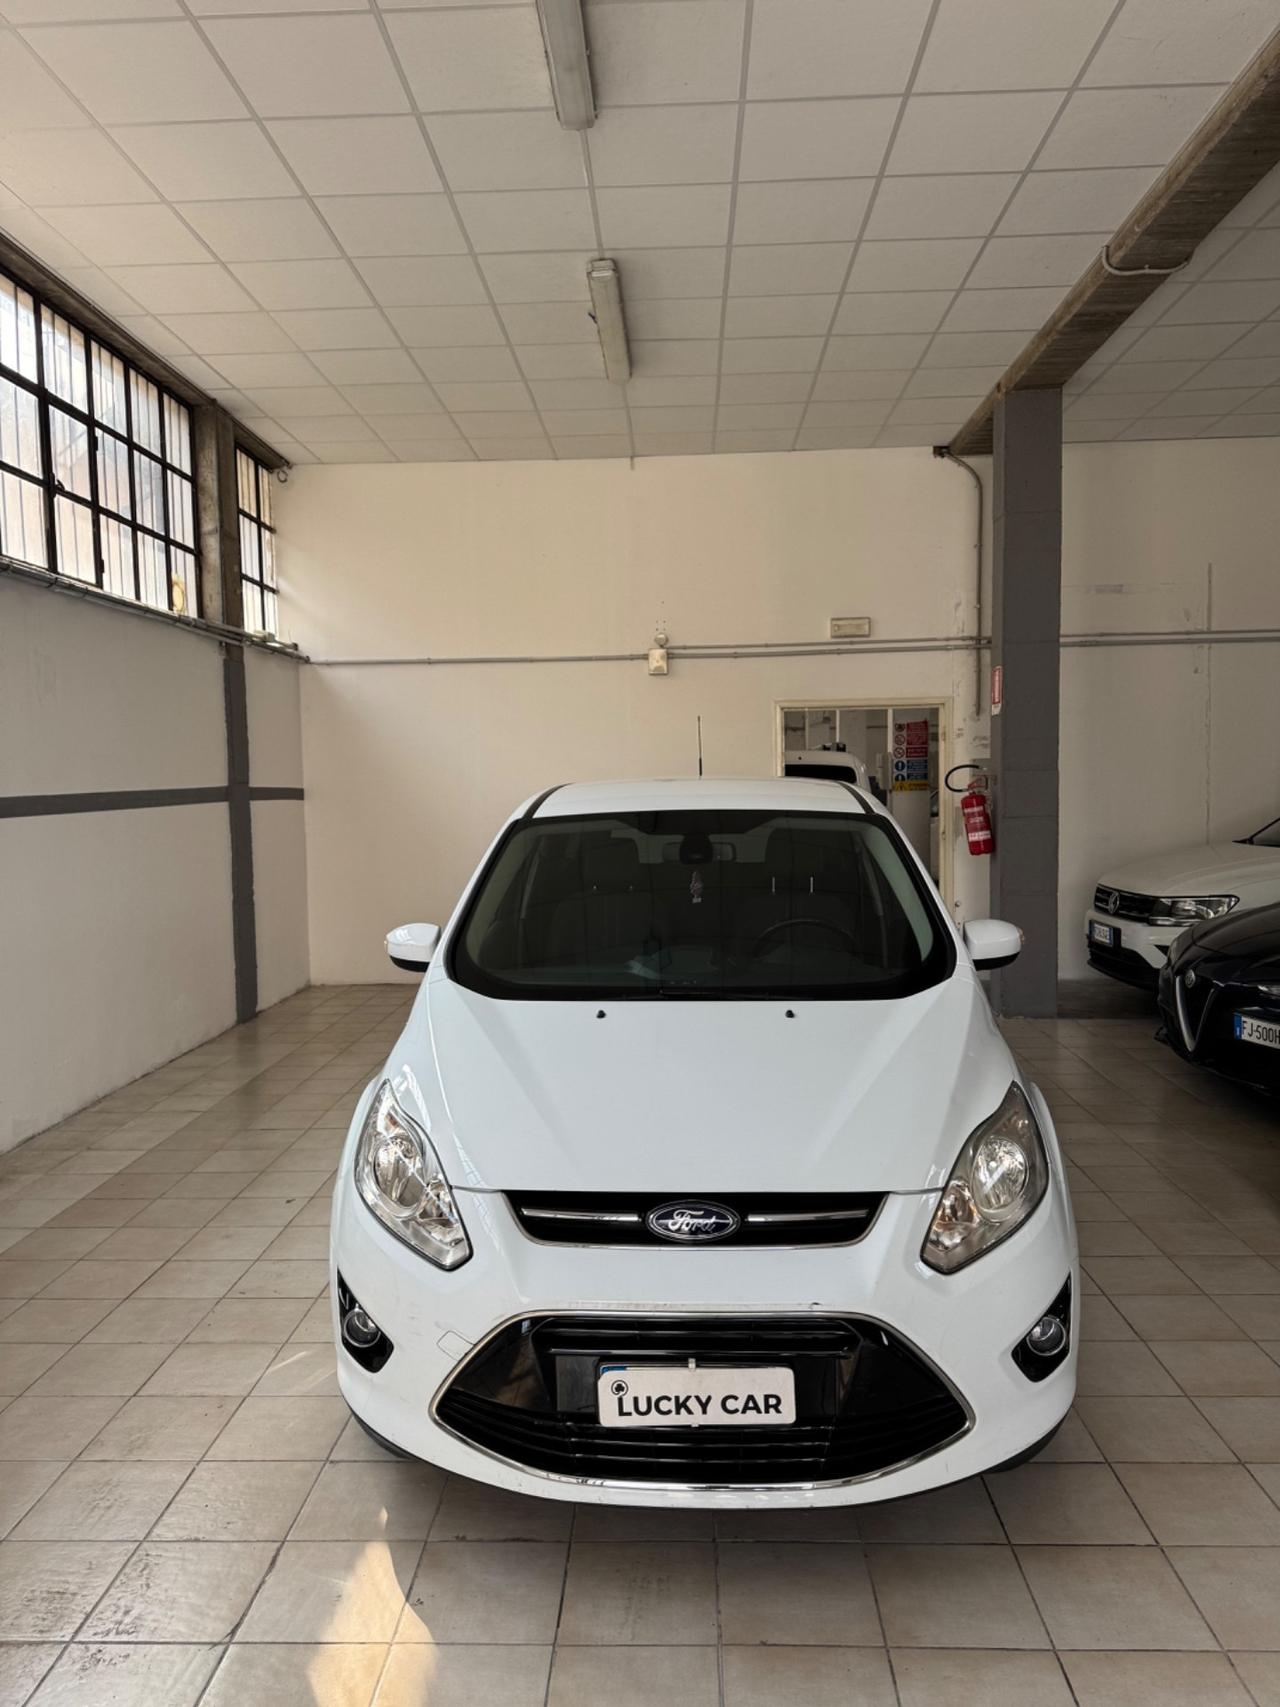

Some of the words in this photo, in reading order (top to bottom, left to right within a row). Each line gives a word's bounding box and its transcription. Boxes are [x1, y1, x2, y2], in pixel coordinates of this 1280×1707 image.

[668, 1208, 716, 1234] Ford
[617, 1394, 713, 1417] LUCKY
[720, 1394, 783, 1415] CAR
